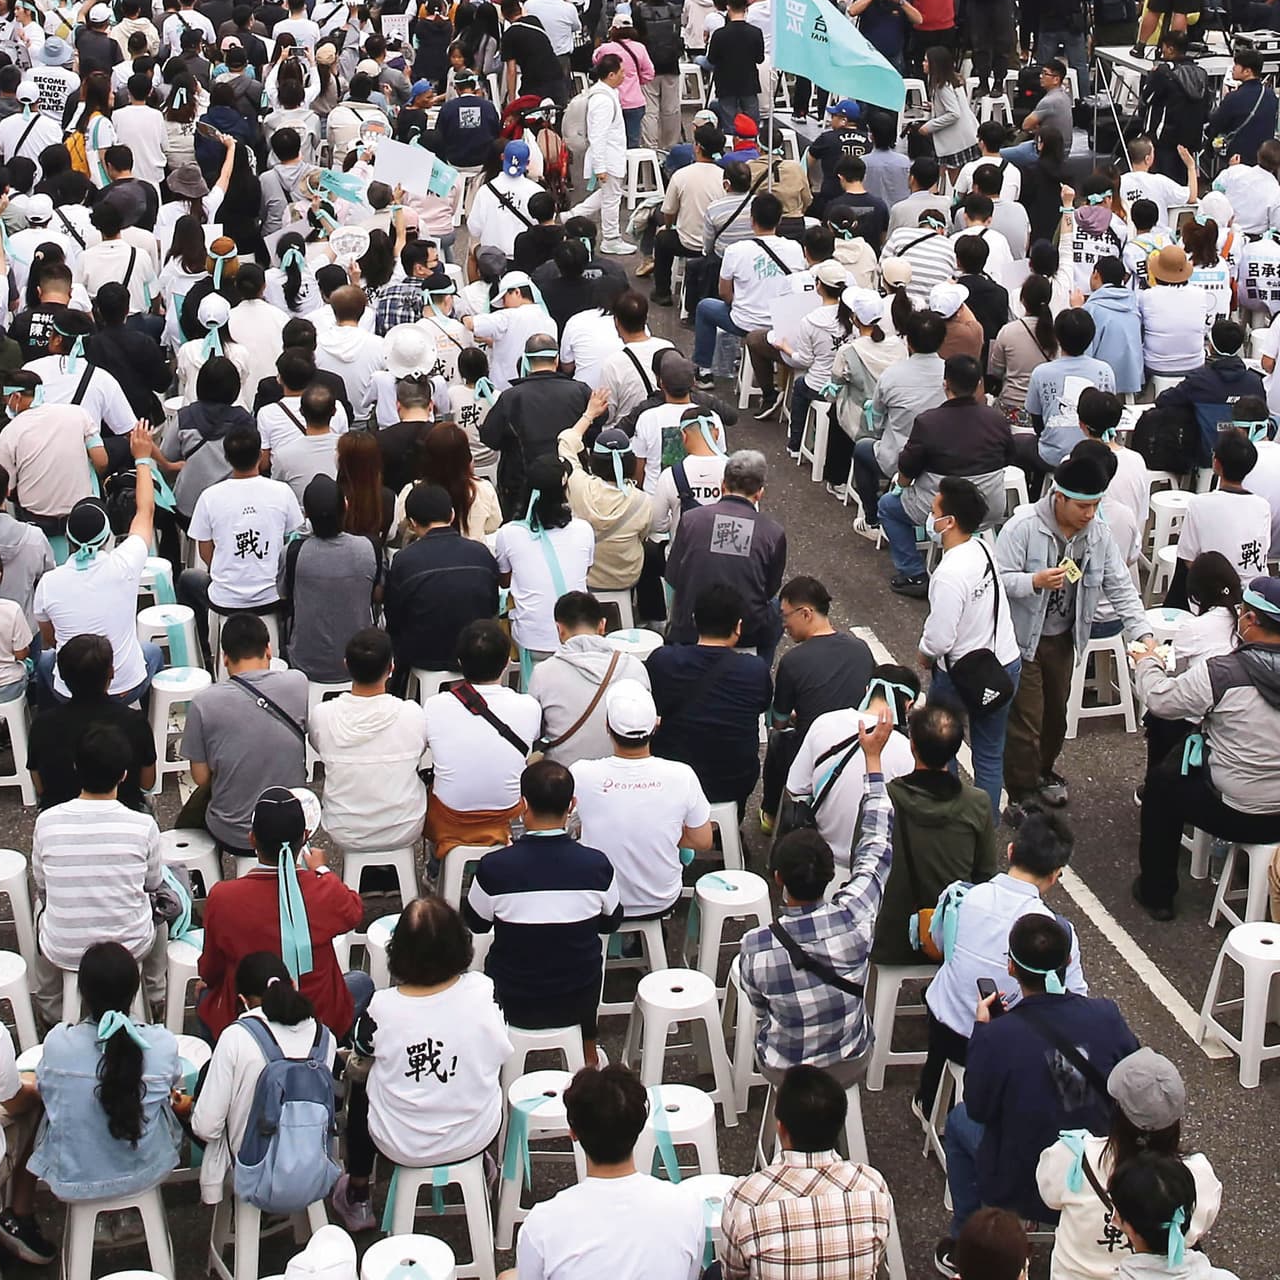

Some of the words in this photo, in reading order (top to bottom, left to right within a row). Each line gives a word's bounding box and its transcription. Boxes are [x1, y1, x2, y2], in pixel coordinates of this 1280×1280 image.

[33, 76, 67, 86] BECOME
[703, 487, 721, 498] DO
[233, 528, 269, 560] 戰!
[714, 520, 751, 552] 戰!
[1237, 539, 1267, 573] 戰!
[403, 1037, 458, 1084] 戰!
